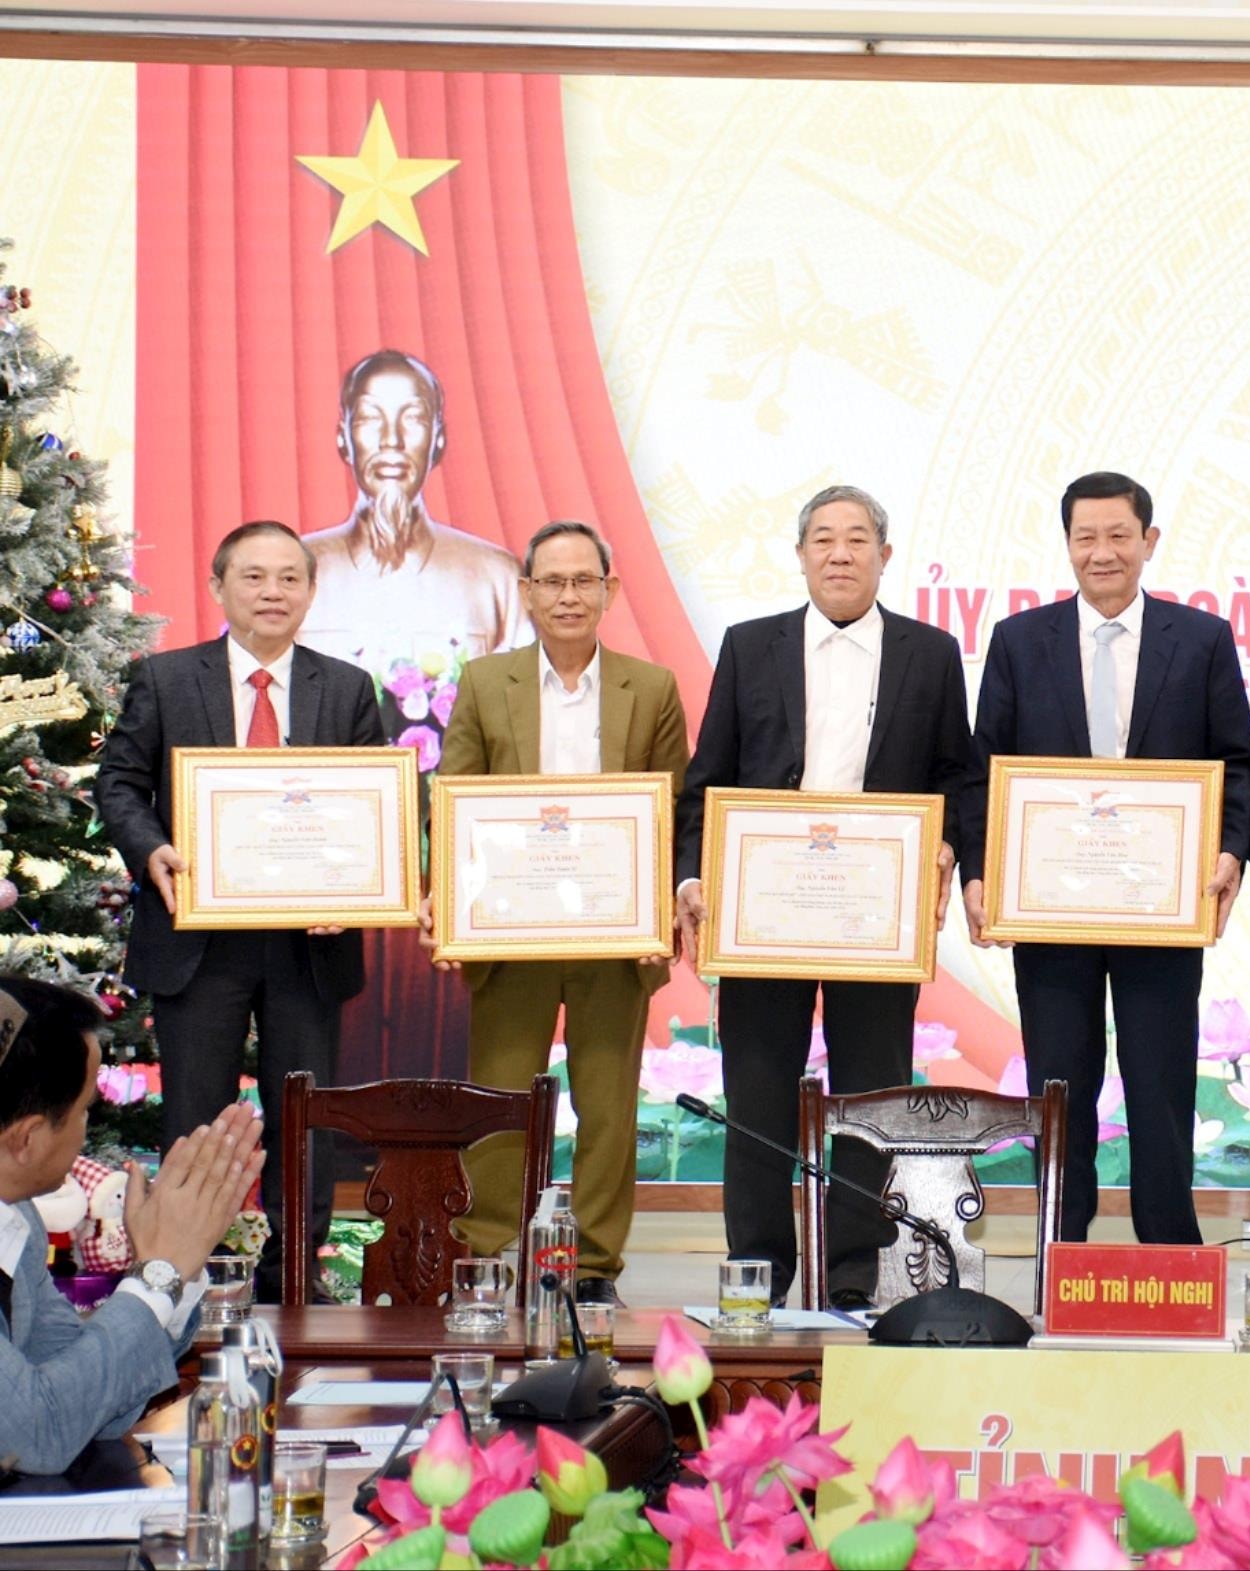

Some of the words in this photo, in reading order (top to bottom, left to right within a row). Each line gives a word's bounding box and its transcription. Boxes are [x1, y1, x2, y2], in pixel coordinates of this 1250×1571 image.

[1059, 1272, 1096, 1302] CHỦ
[1101, 1275, 1129, 1304] TRÌ
[1134, 1276, 1164, 1309] HỘI
[1170, 1280, 1213, 1310] NGHỊ
